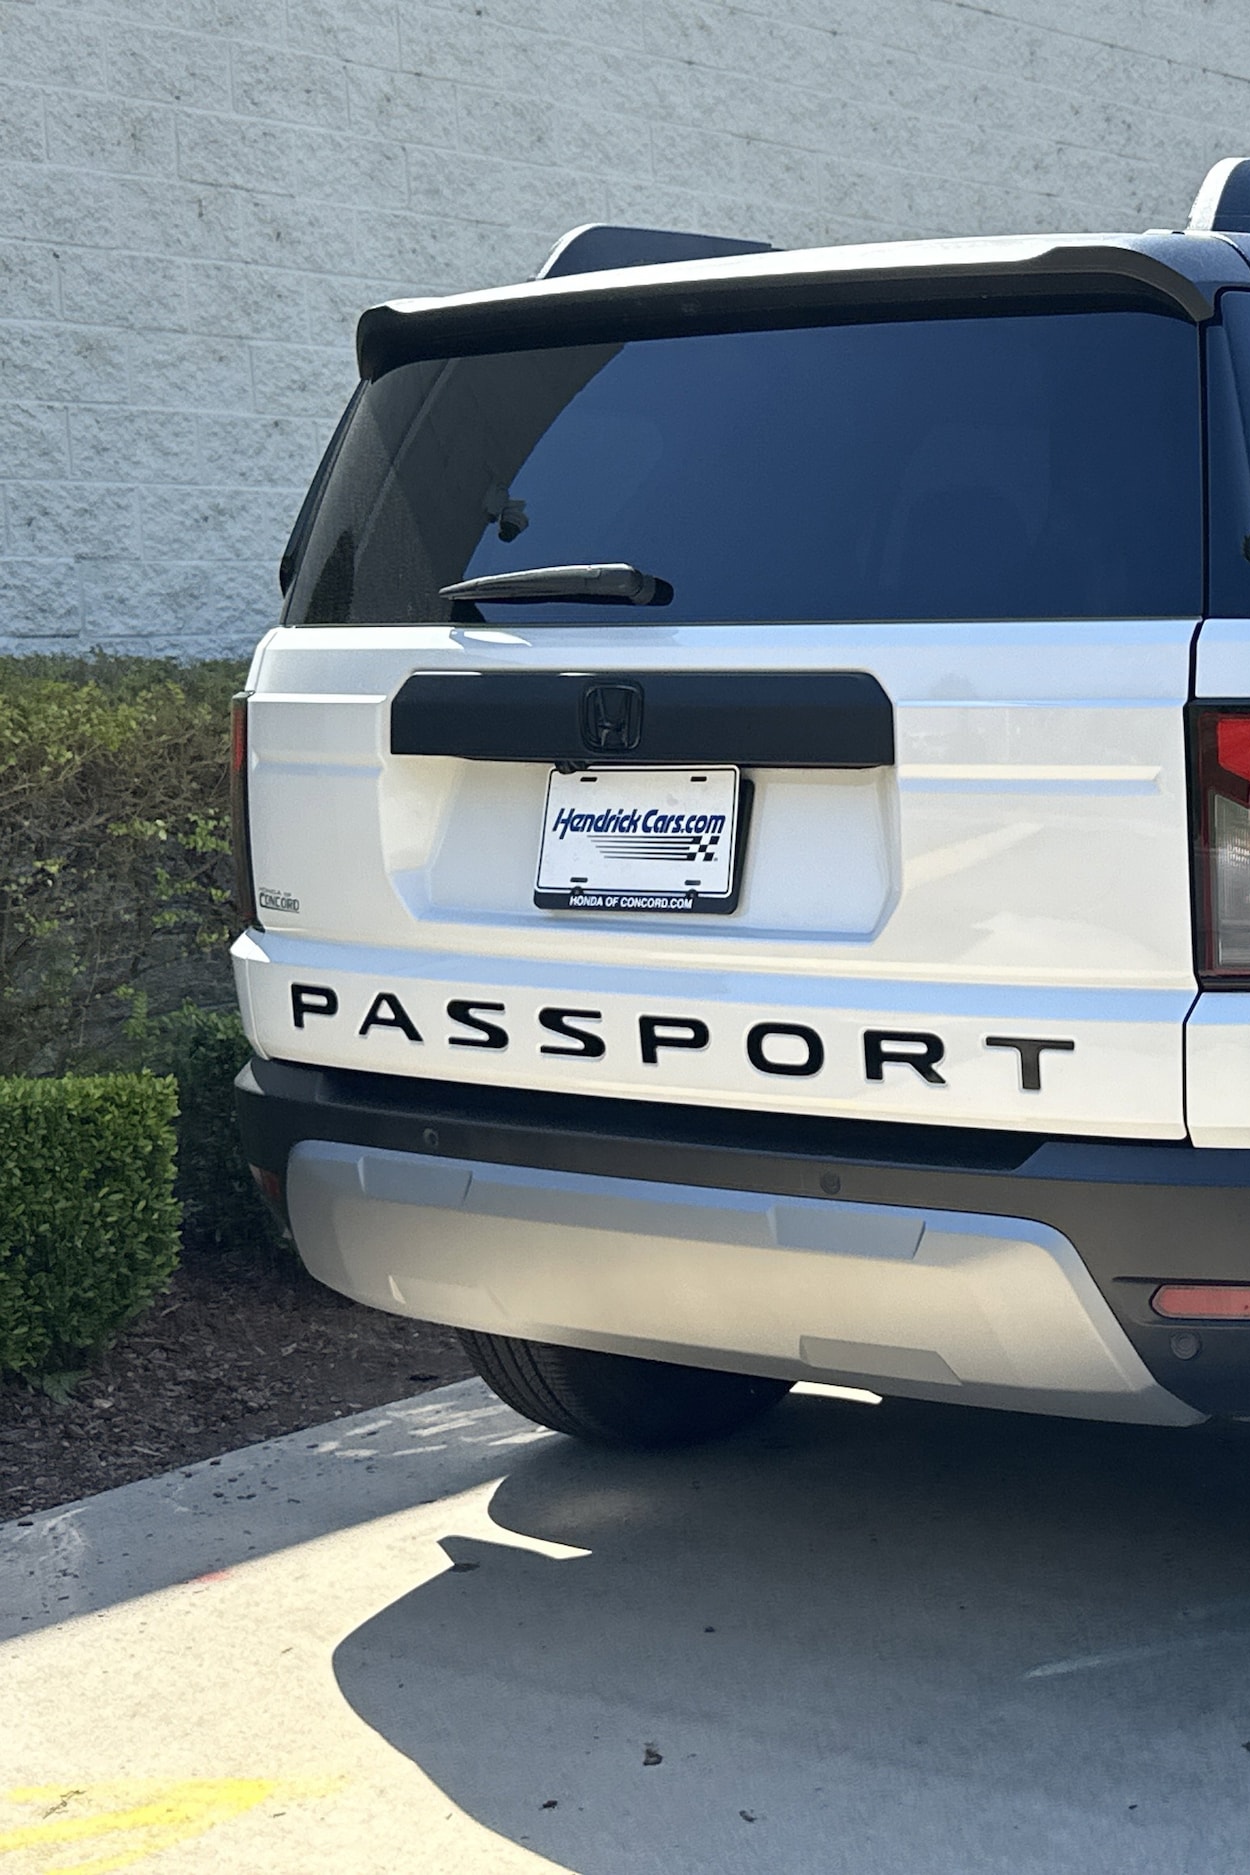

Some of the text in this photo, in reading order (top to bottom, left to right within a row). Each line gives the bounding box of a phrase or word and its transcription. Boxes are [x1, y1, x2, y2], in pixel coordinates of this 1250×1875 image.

[569, 895, 693, 909] HONDA OF CONCORD.COM
[290, 983, 1075, 1091] PASSPORT
